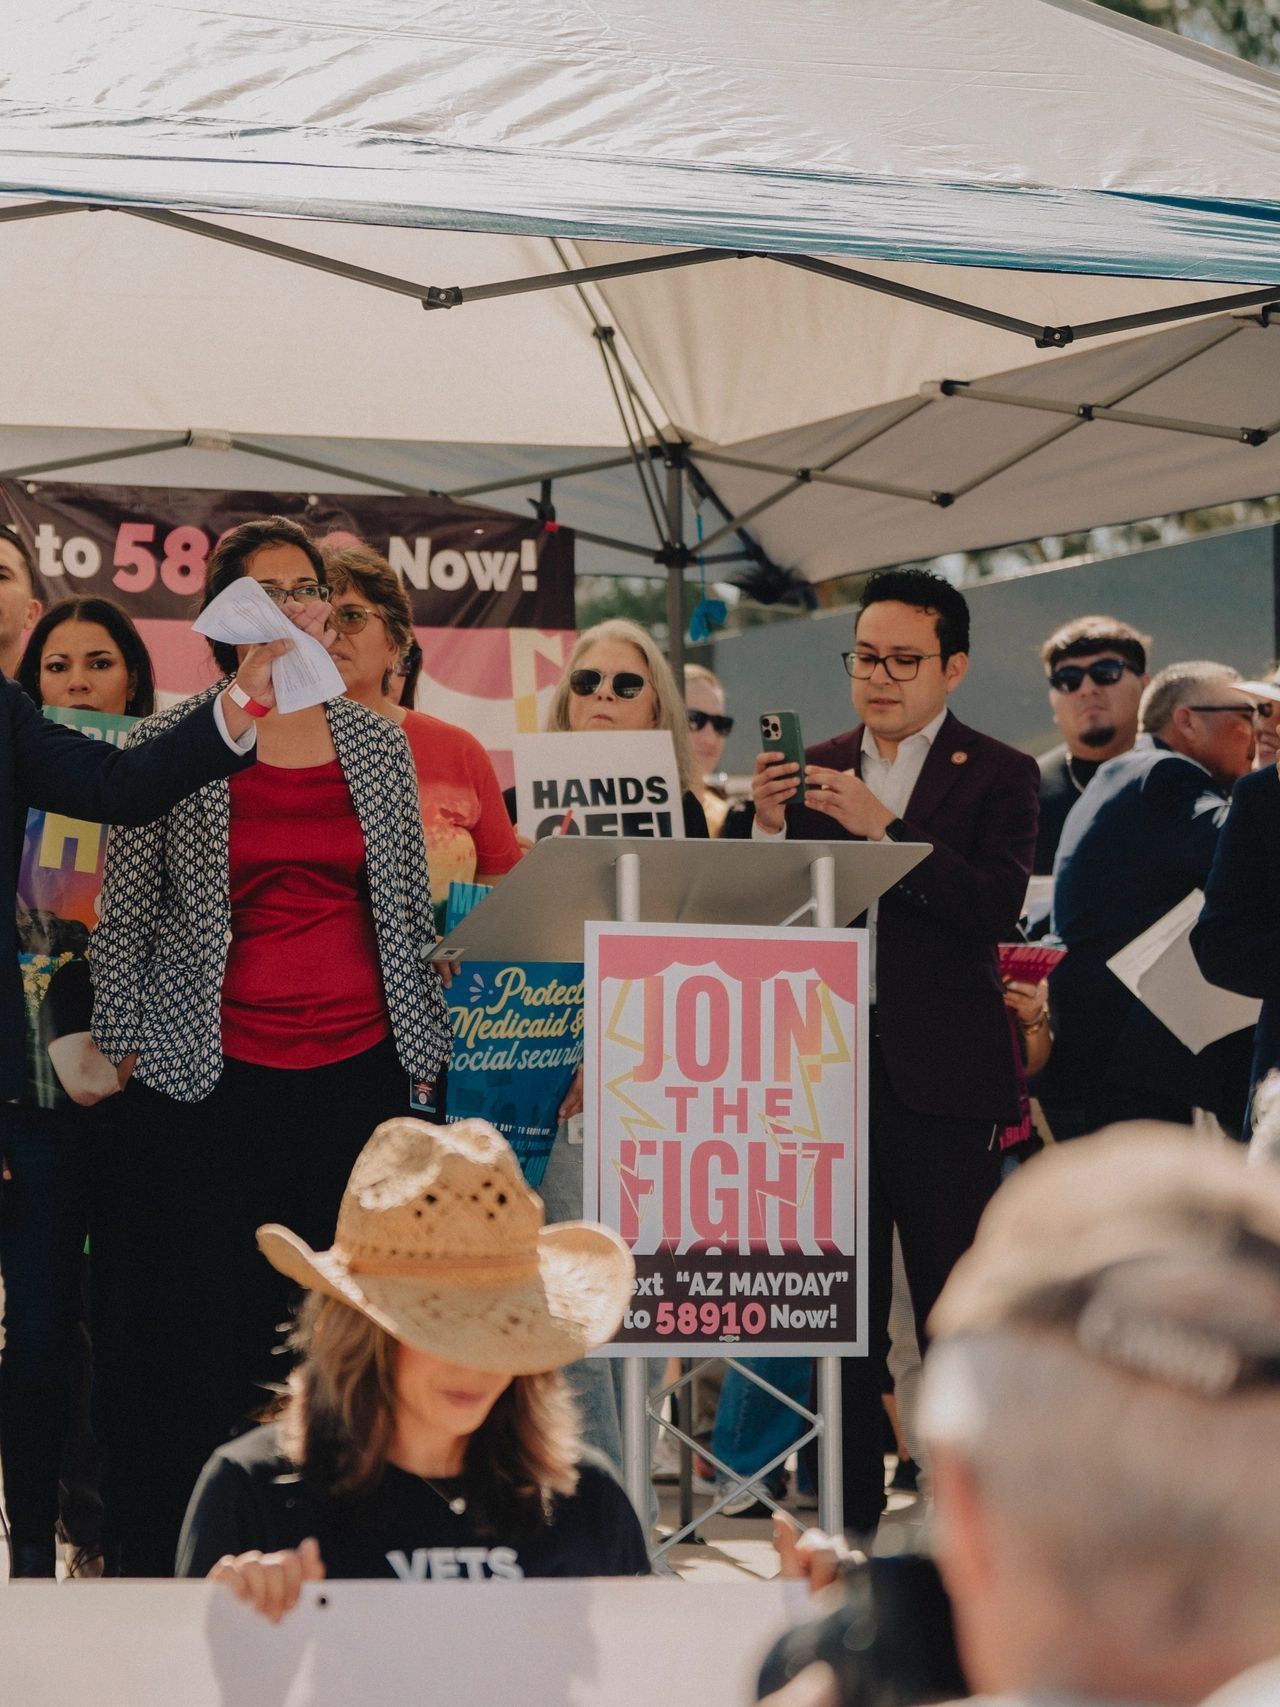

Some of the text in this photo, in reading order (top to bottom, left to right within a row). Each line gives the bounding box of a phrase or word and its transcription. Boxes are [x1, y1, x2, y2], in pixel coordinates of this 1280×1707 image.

[35, 524, 101, 578] to
[388, 536, 538, 592] Now!
[532, 776, 669, 809] HANDS
[485, 967, 585, 1015] Protect
[449, 1006, 572, 1049] Medicaid
[632, 975, 822, 1083] JOIN
[664, 1086, 793, 1134] THE
[619, 1139, 844, 1240] FIGHT
[631, 1271, 848, 1296] ext “AZ MAYDAY”
[623, 1302, 837, 1334] to 58910 Now!
[385, 1546, 523, 1583] VETS
